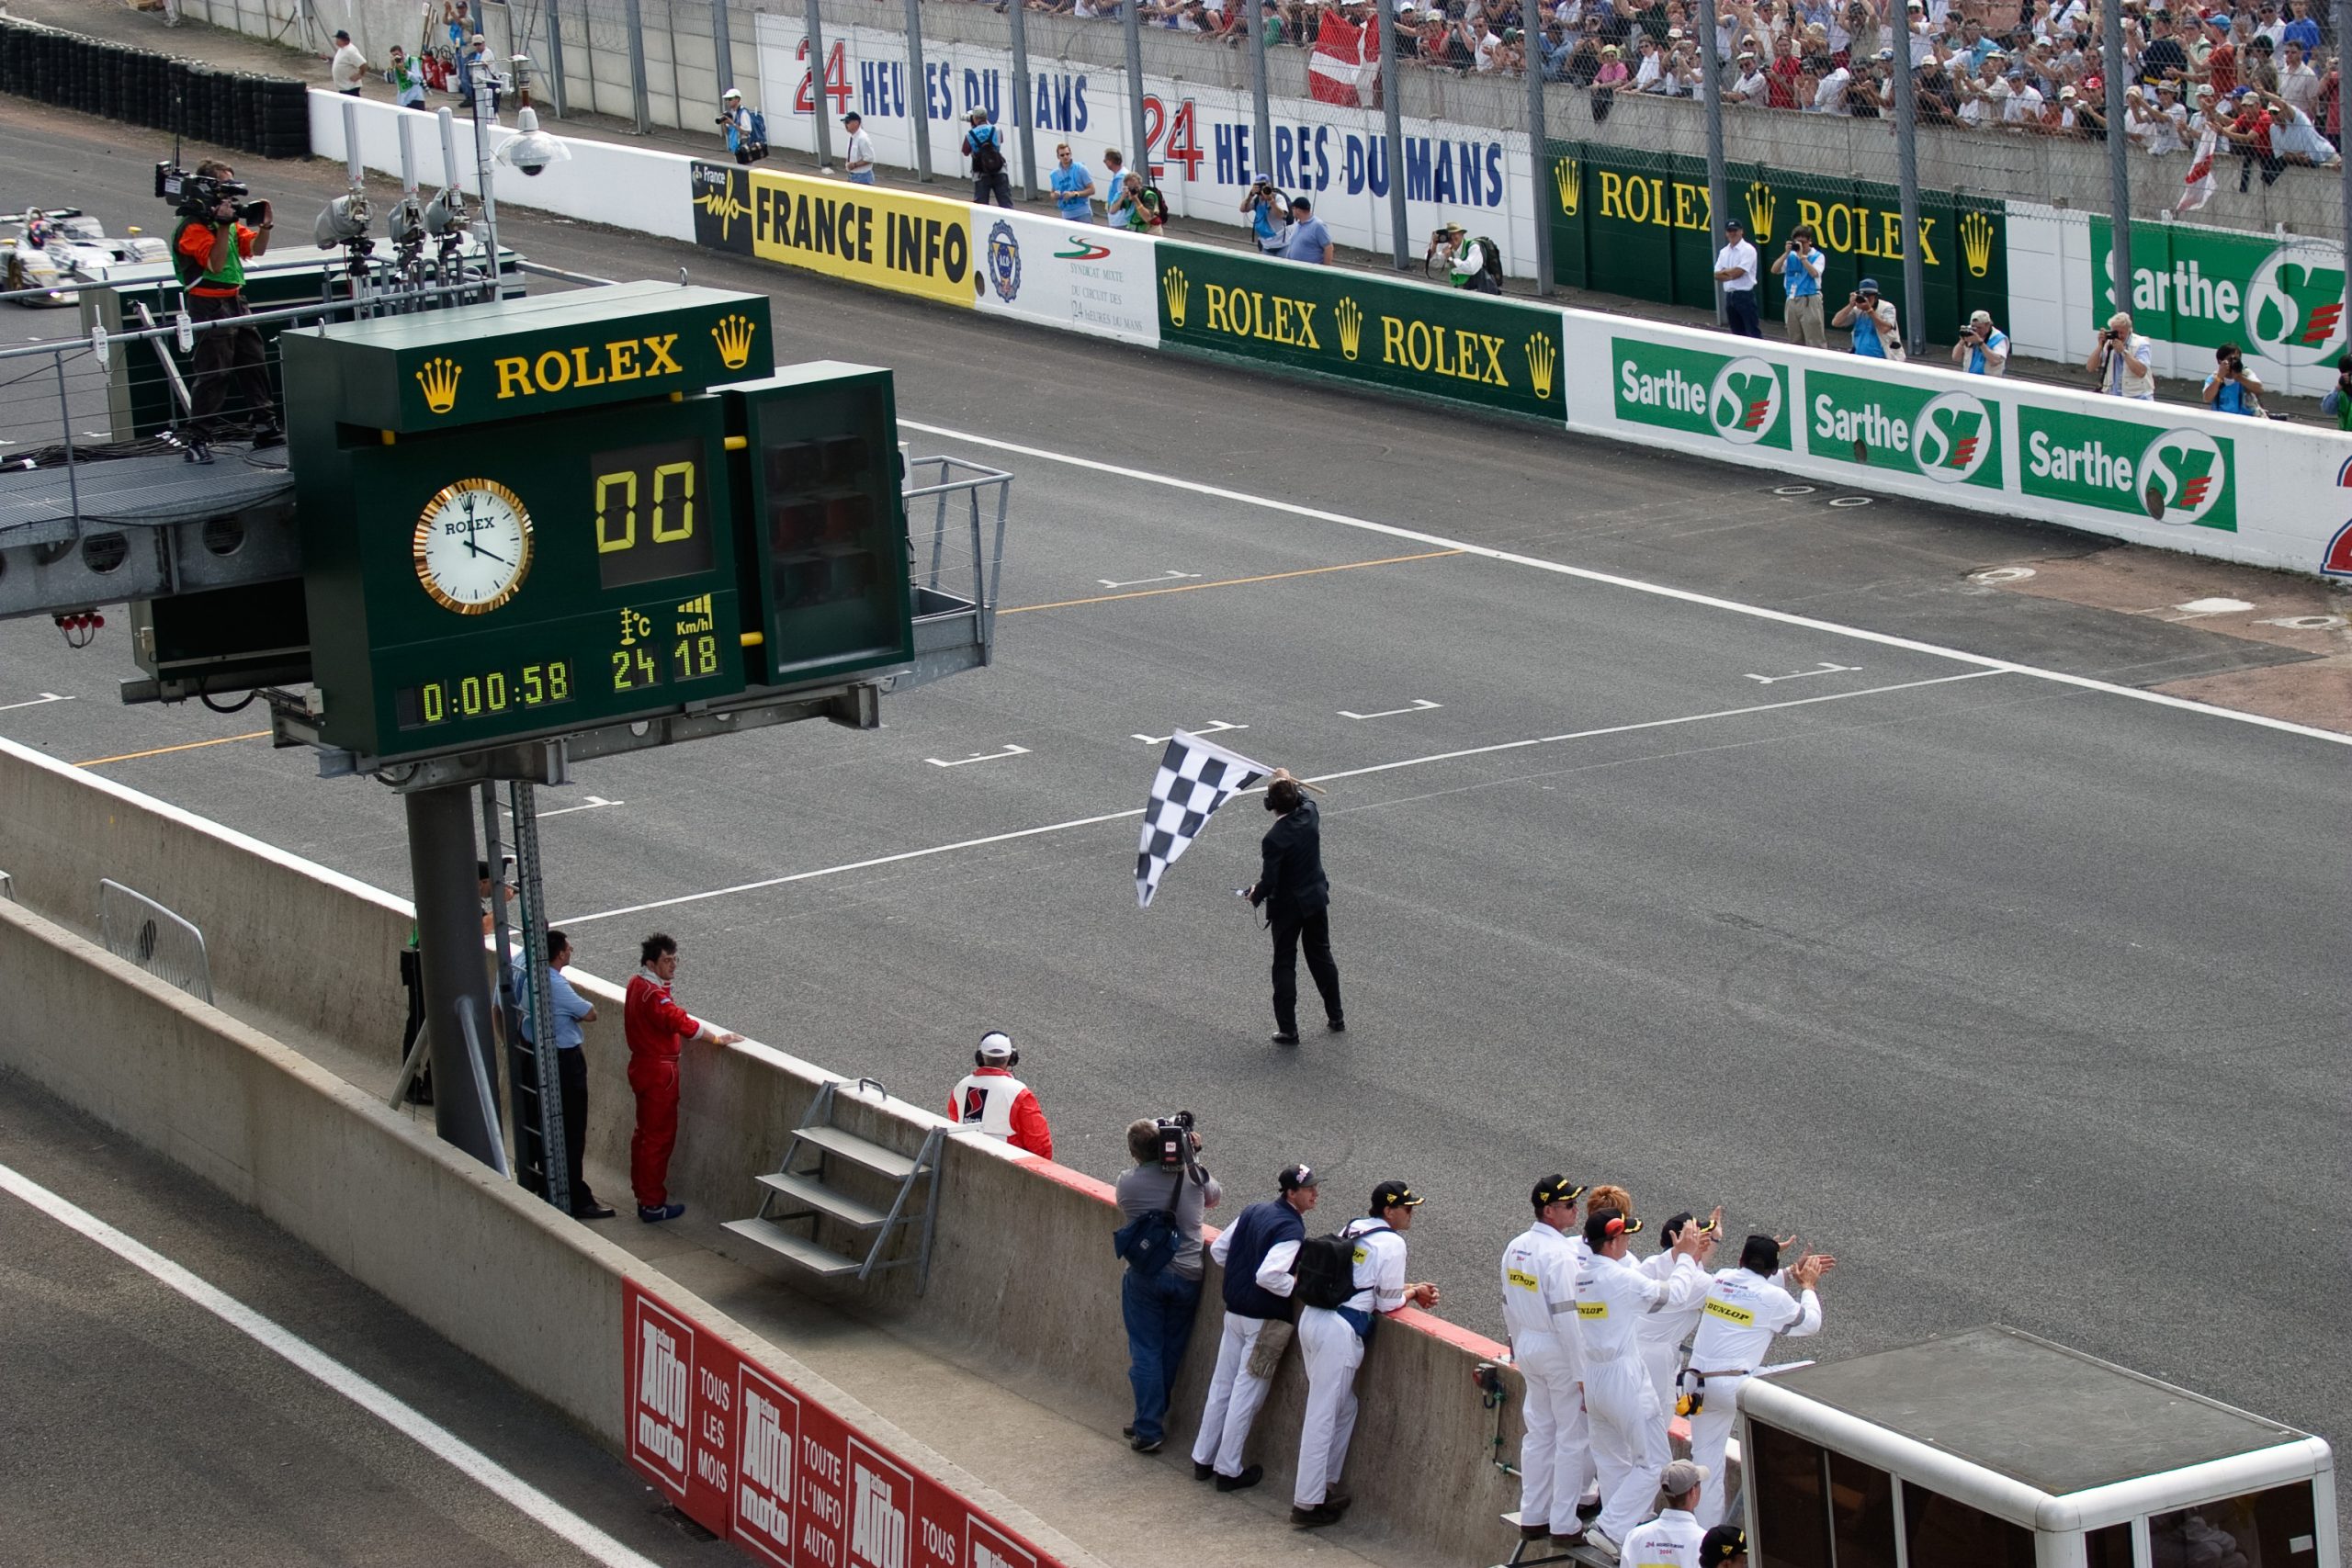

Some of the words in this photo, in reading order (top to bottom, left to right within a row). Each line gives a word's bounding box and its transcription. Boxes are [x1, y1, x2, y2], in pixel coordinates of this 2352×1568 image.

[861, 61, 952, 120] HEUES
[965, 68, 1000, 126] DU
[704, 166, 726, 185] France
[1215, 123, 1329, 192] HERES
[1346, 134, 1390, 198] DU
[1407, 137, 1502, 208] MANS
[693, 168, 752, 242] info
[1796, 198, 1940, 265] ROLEX
[756, 186, 873, 264] FRANCE
[887, 211, 967, 284] INFO
[1071, 285, 1080, 297] DU
[1082, 287, 1107, 302] CIRCUIT
[1110, 292, 1123, 305] DES
[1102, 269, 1124, 283] MIXTE
[1072, 299, 1083, 319] 24
[1124, 317, 1142, 331] MANS
[1204, 283, 1320, 350] ROLEX
[1381, 315, 1510, 388] ROLEX
[495, 333, 683, 400] ROLEX
[1621, 359, 1707, 416] Sarthe
[1815, 393, 1909, 452] Sarthe
[2029, 430, 2133, 492] Sarthe
[445, 516, 495, 536] ROLEX
[596, 461, 695, 554] 00
[676, 617, 708, 636] Km/h
[612, 648, 655, 690] 24
[674, 636, 717, 676] 18
[423, 661, 568, 722] 0:00:58
[1707, 1303, 1750, 1321] DUNLOP
[640, 1318, 686, 1429] Auto
[700, 1366, 730, 1412] TOUS
[639, 1411, 684, 1472] moto
[703, 1410, 725, 1450] LES
[742, 1386, 792, 1504] Auto
[697, 1448, 728, 1494] MOIS
[803, 1434, 842, 1488] TOUTE
[741, 1483, 789, 1547] moto
[800, 1475, 842, 1530] L'INFO
[852, 1461, 906, 1568] Auto
[803, 1522, 836, 1568] AUTO
[922, 1516, 956, 1566] TOUS
